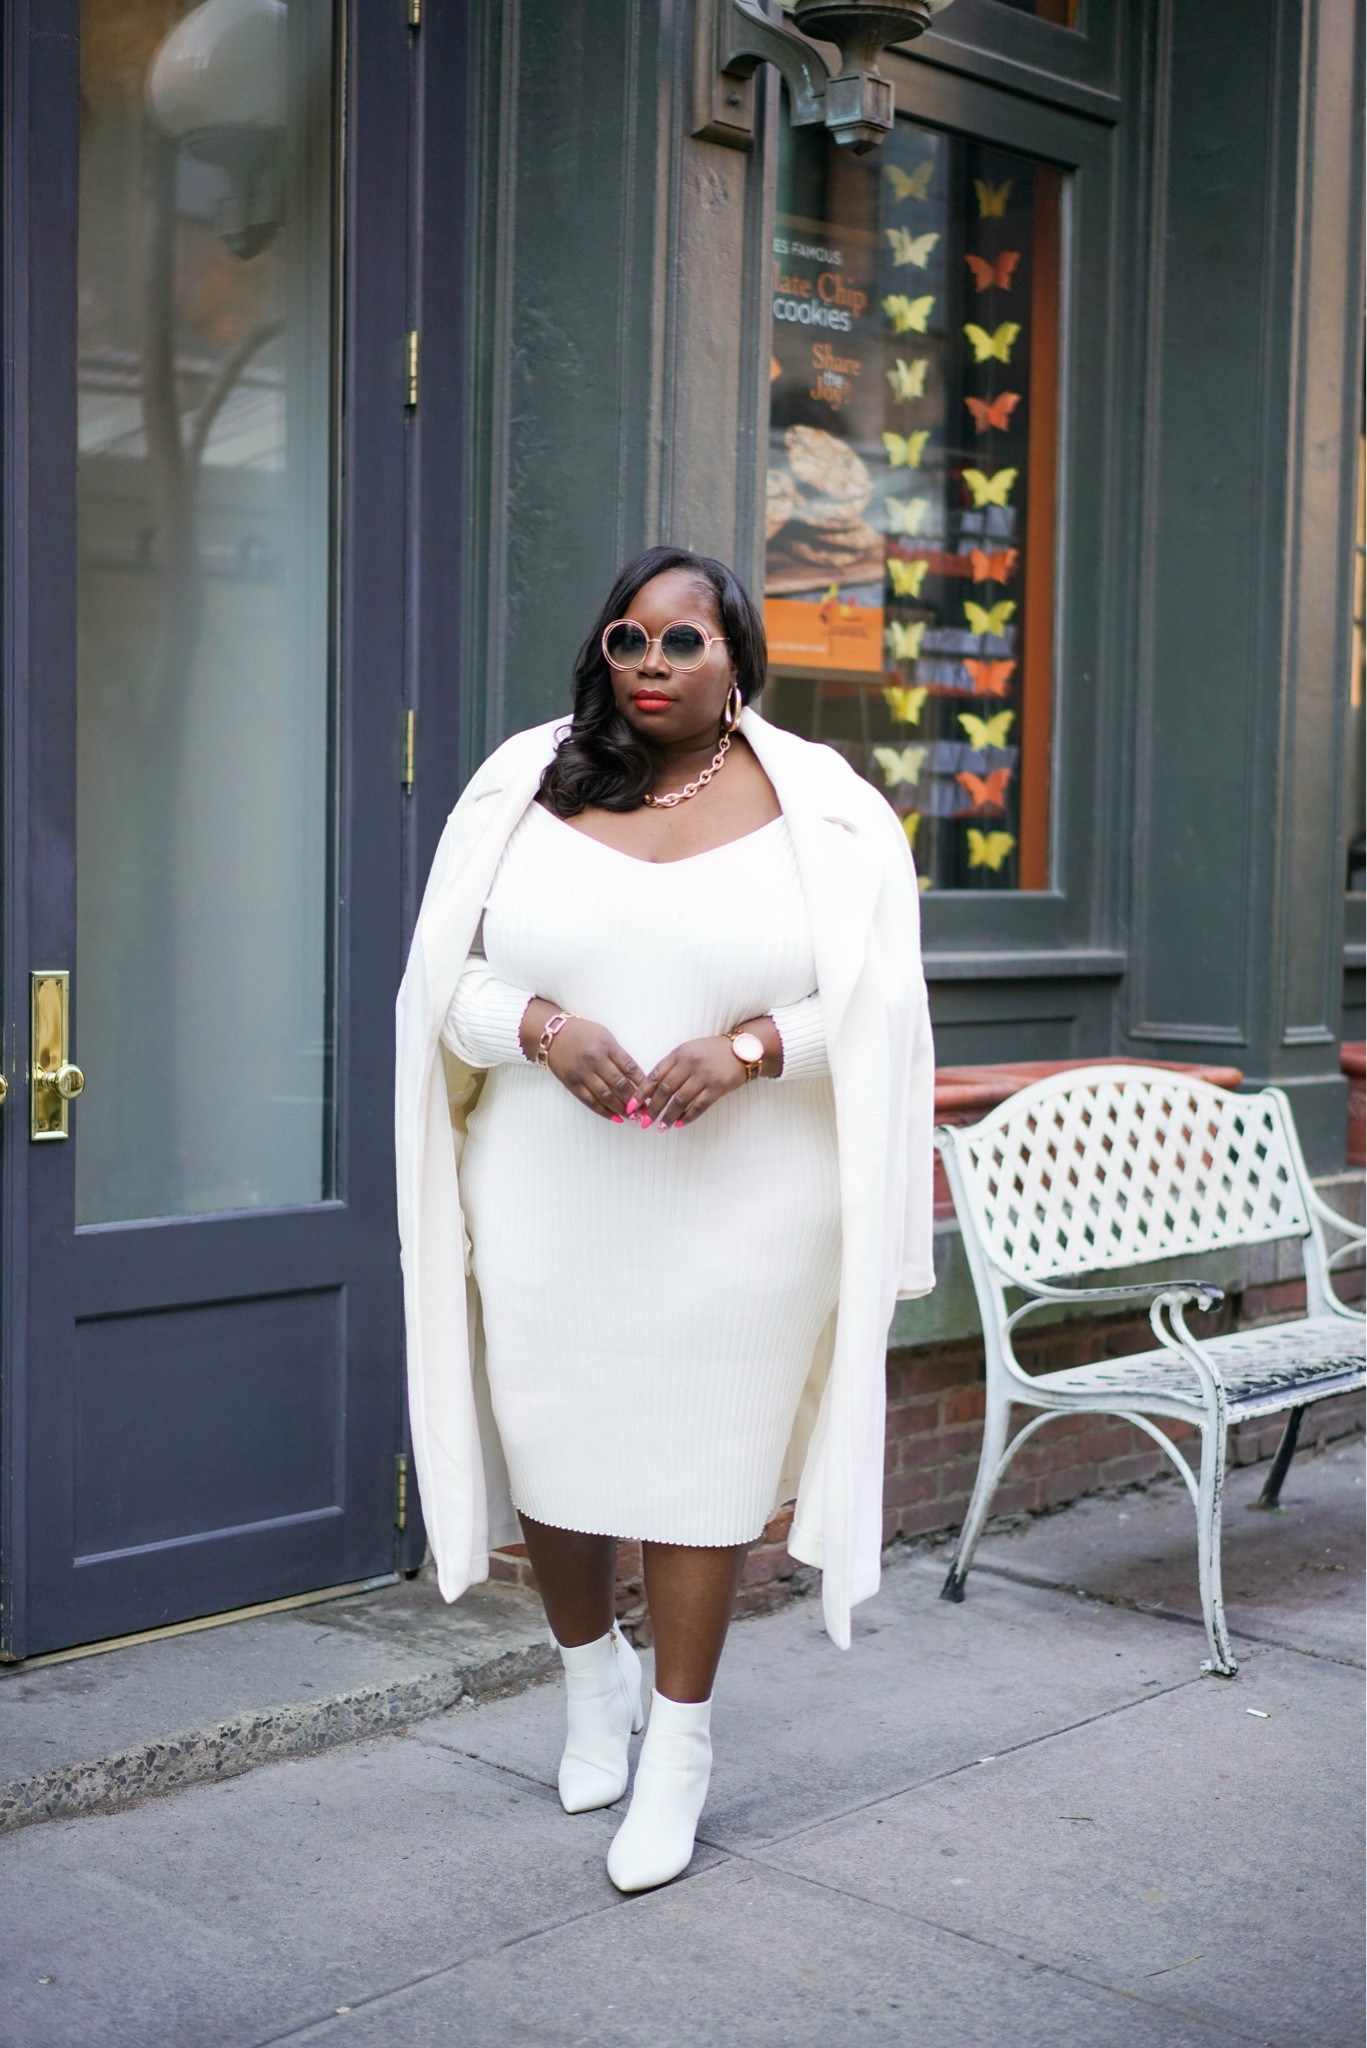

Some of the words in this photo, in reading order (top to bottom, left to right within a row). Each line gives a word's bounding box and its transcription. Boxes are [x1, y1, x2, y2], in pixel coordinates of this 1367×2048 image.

[791, 242, 842, 265] FAMOUS
[817, 273, 866, 316] Chip
[773, 298, 851, 332] cookies
[812, 343, 862, 376] Share
[824, 371, 844, 388] the
